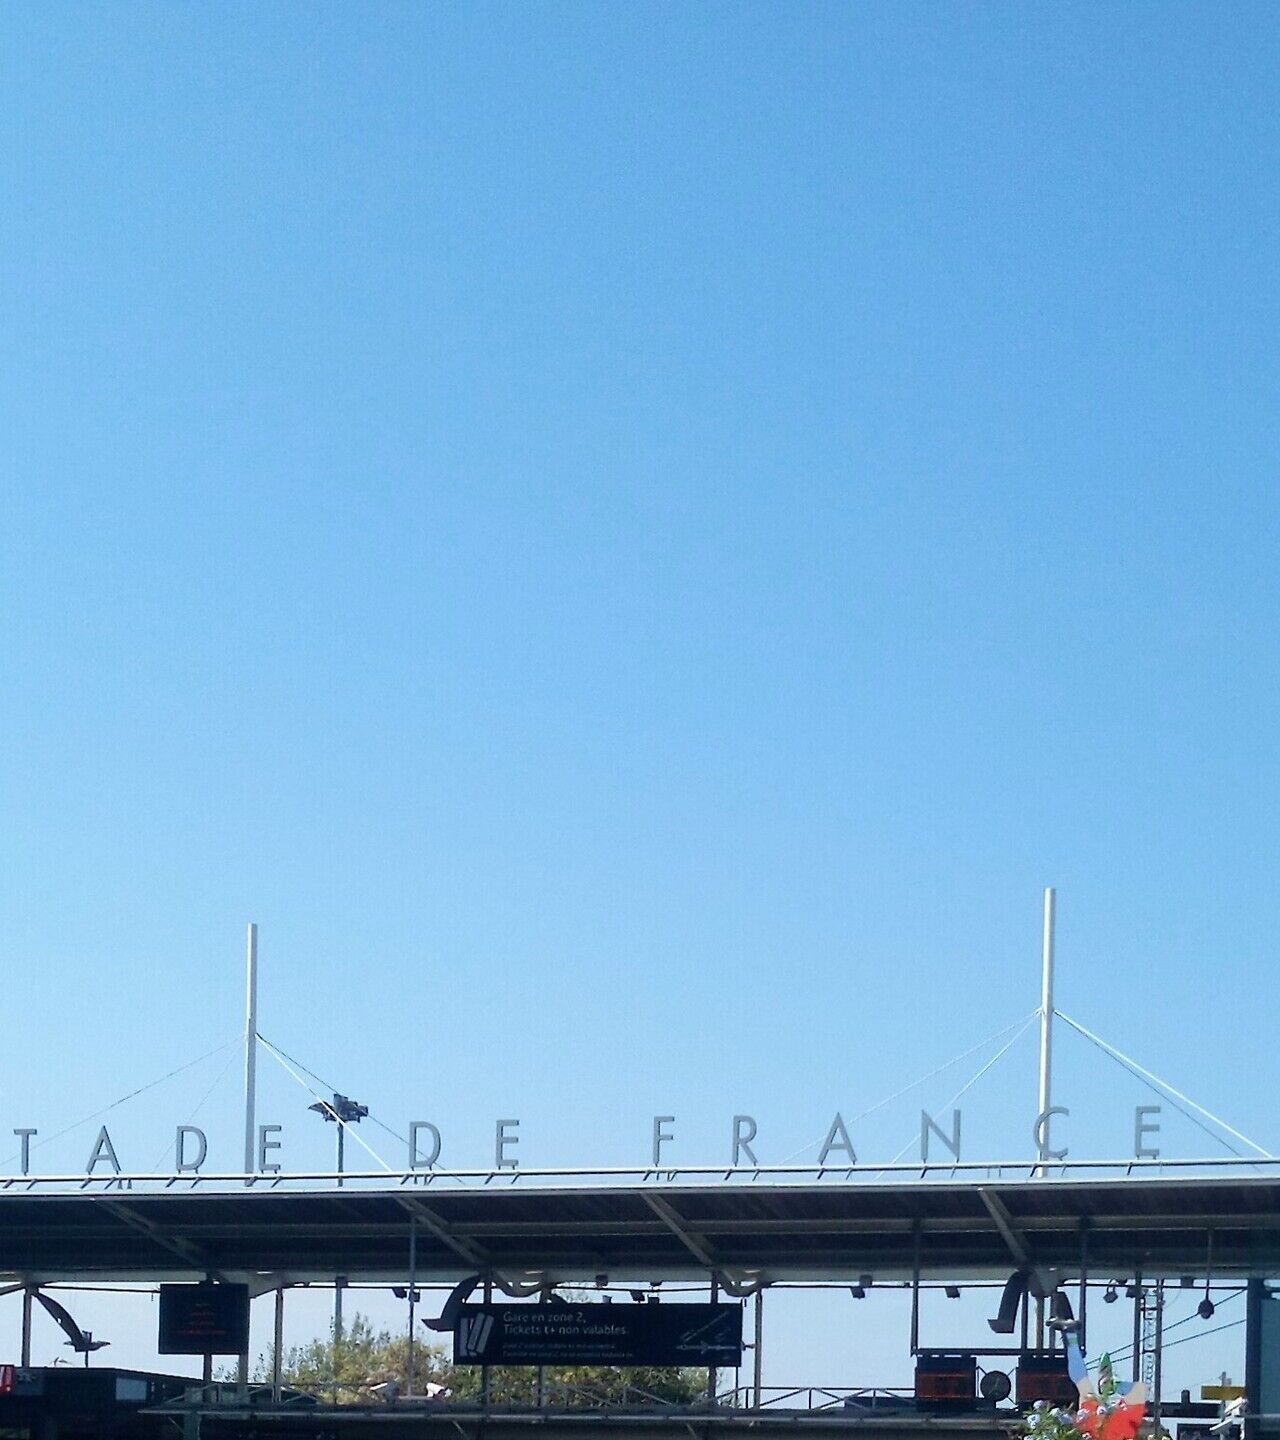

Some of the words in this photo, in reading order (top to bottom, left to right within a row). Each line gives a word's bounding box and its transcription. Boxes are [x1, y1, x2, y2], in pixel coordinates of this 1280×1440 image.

[409, 1119, 520, 1168] DE
[653, 1105, 1161, 1166] FRANCE
[503, 1324, 543, 1335] Tickets
[558, 1326, 580, 1335] non
